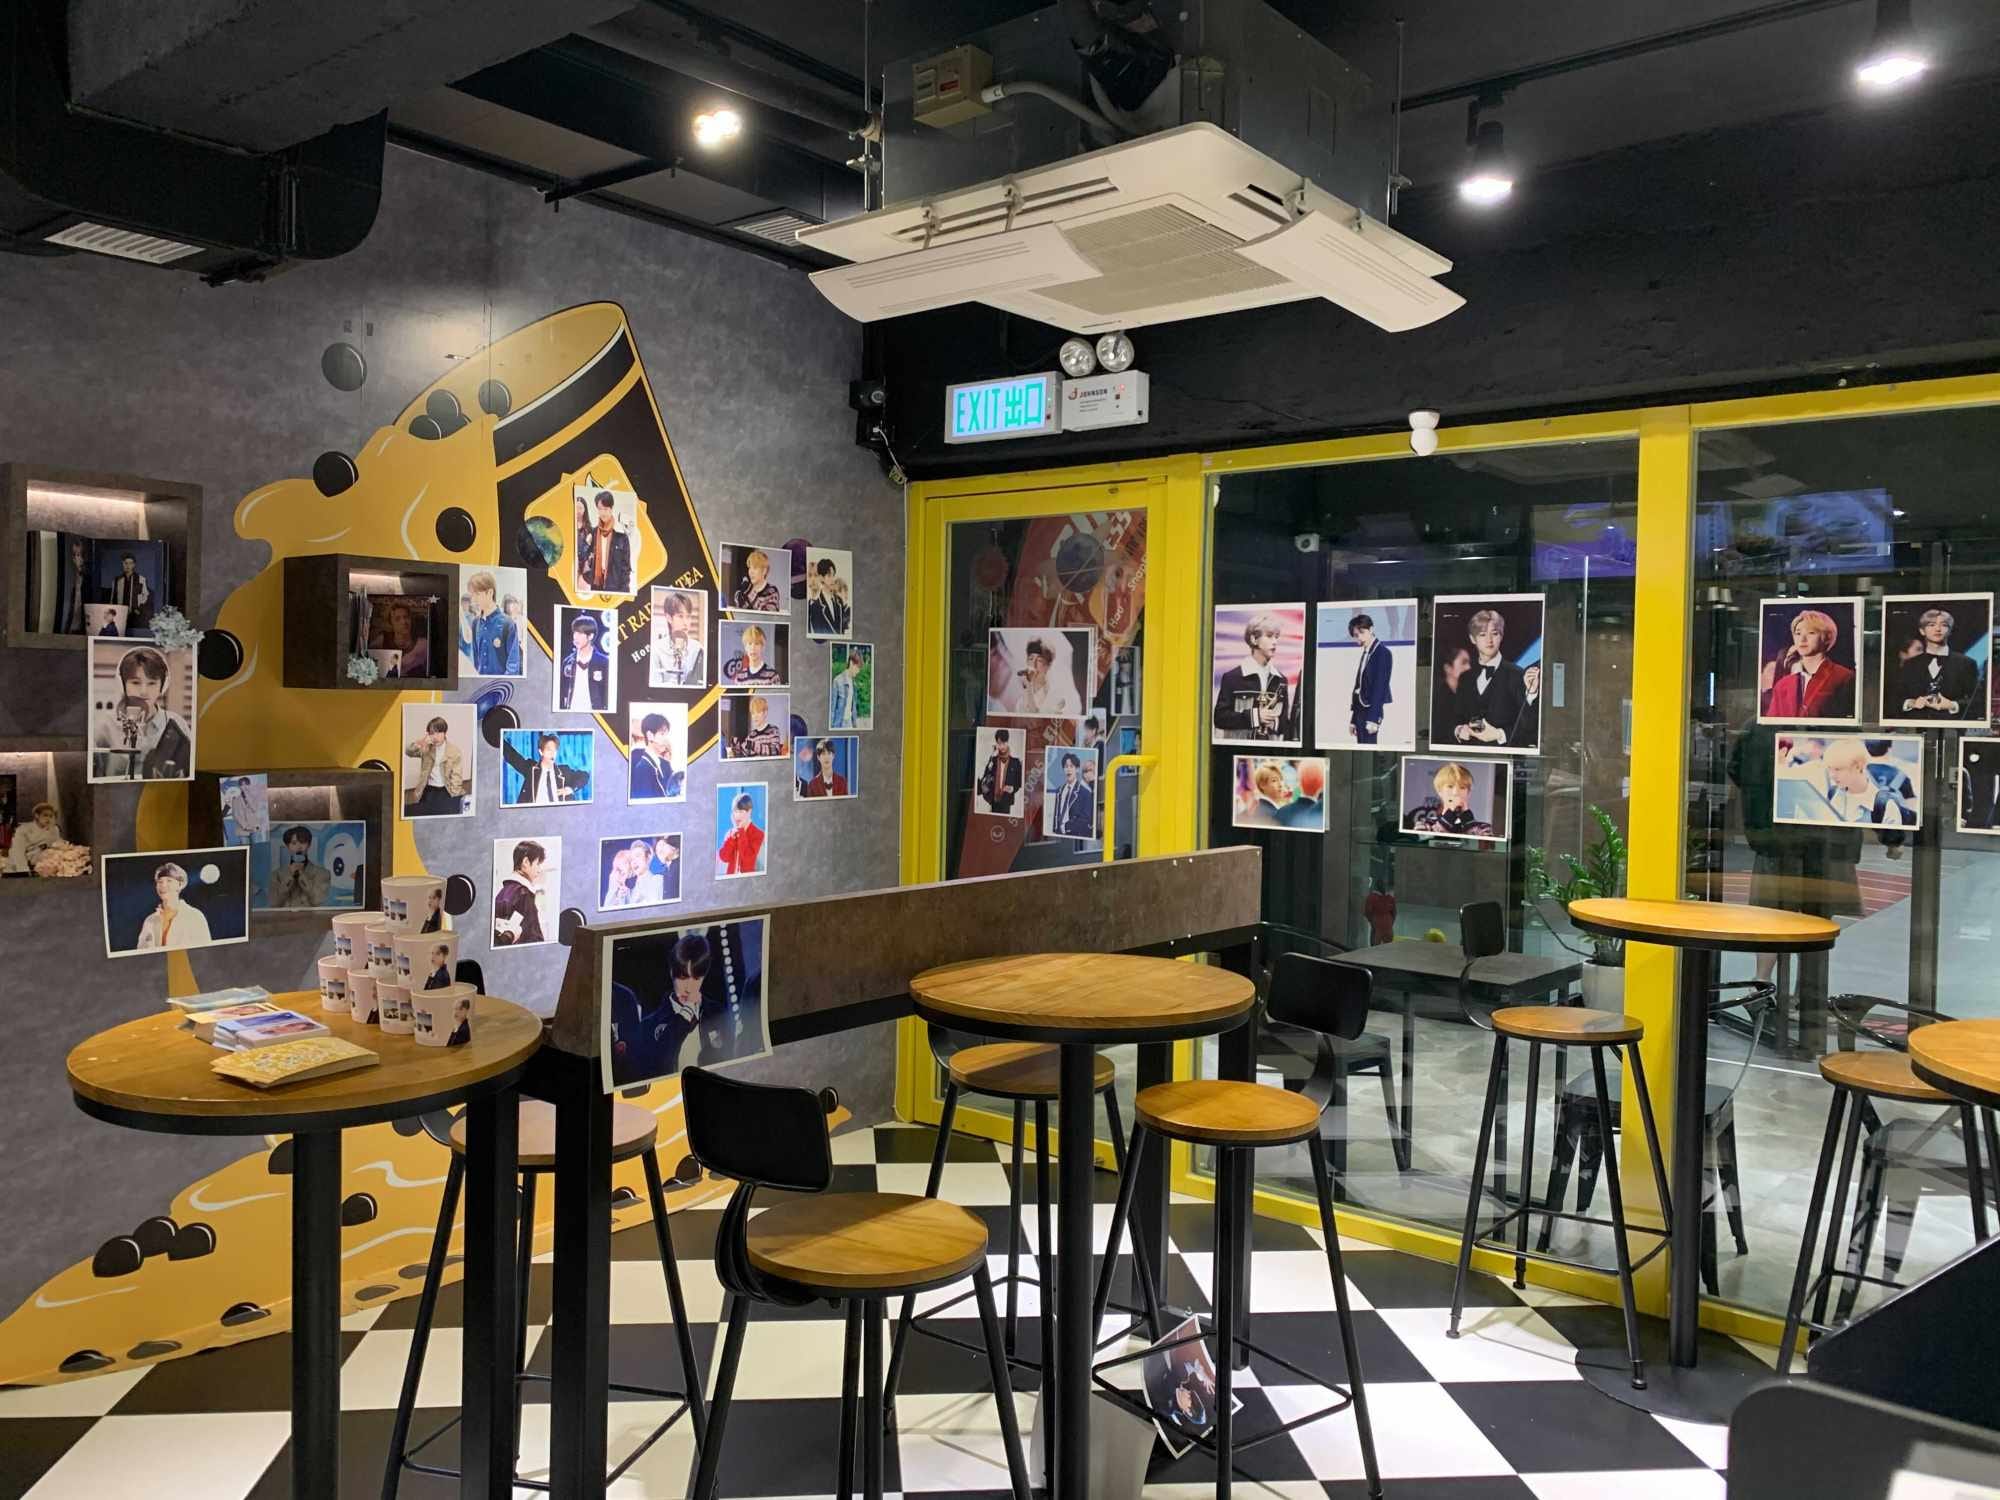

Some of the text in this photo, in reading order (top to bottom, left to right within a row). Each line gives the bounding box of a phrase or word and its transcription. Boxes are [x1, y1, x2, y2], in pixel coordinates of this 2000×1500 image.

[957, 384, 1042, 433] EXIT 出口
[675, 565, 704, 589] TEA
